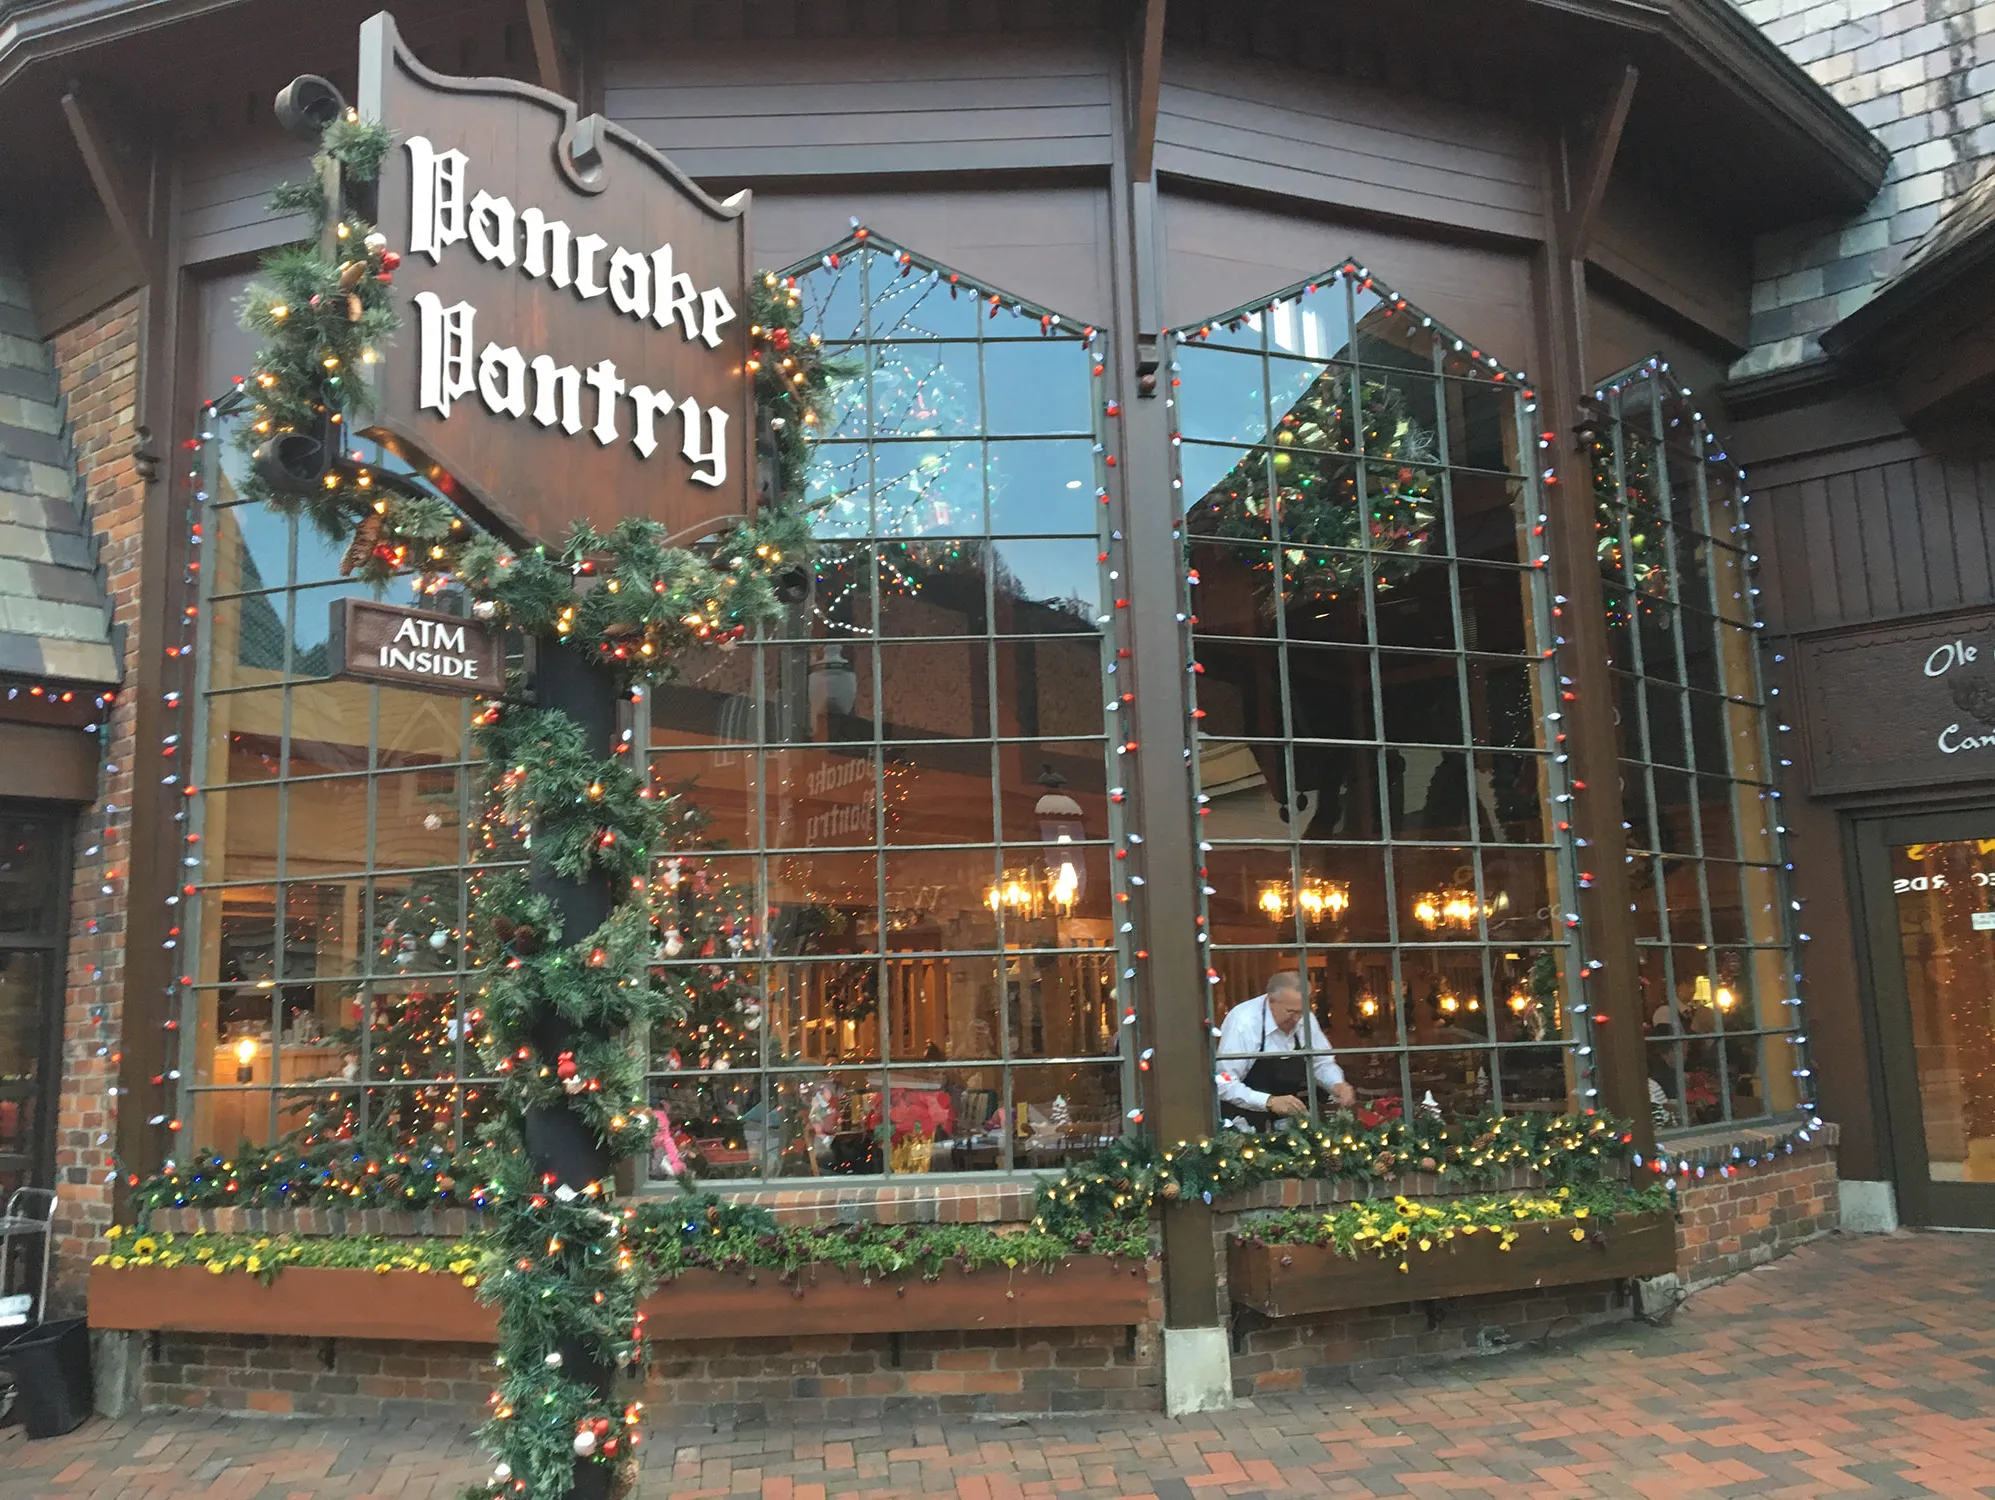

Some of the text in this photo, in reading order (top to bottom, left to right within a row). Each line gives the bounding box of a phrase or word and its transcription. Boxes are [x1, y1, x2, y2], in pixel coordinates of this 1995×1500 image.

[403, 136, 736, 348] Pancake
[415, 291, 729, 487] Pantry
[394, 616, 465, 654] ATM
[380, 646, 478, 680] INSIDE
[1924, 640, 1978, 676] Ole
[1938, 724, 1995, 753] Can
